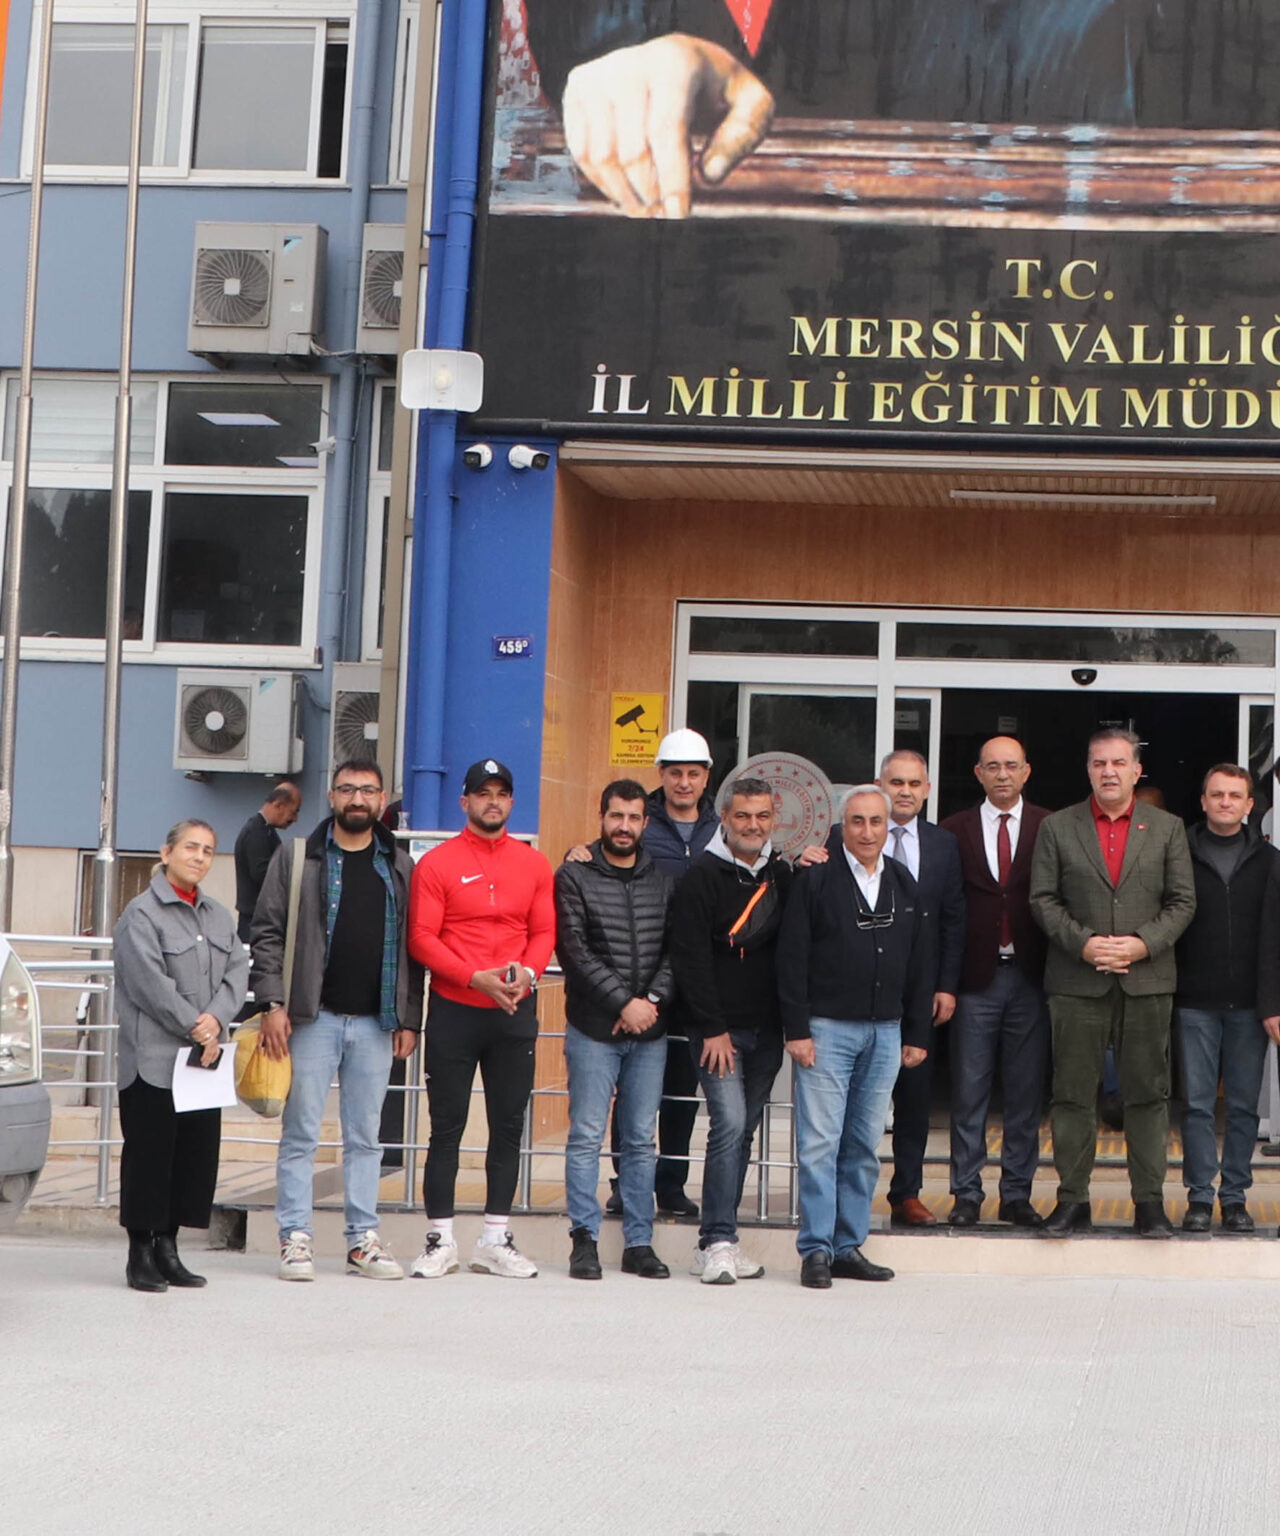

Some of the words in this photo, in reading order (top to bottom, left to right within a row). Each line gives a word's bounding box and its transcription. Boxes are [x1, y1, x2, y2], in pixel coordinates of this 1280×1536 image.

[1005, 258, 1114, 301] T.C.
[788, 310, 1030, 362] MERSİN
[587, 363, 650, 415] İL
[664, 367, 851, 422] MİLLİ
[868, 370, 1102, 427] EĞİTİM
